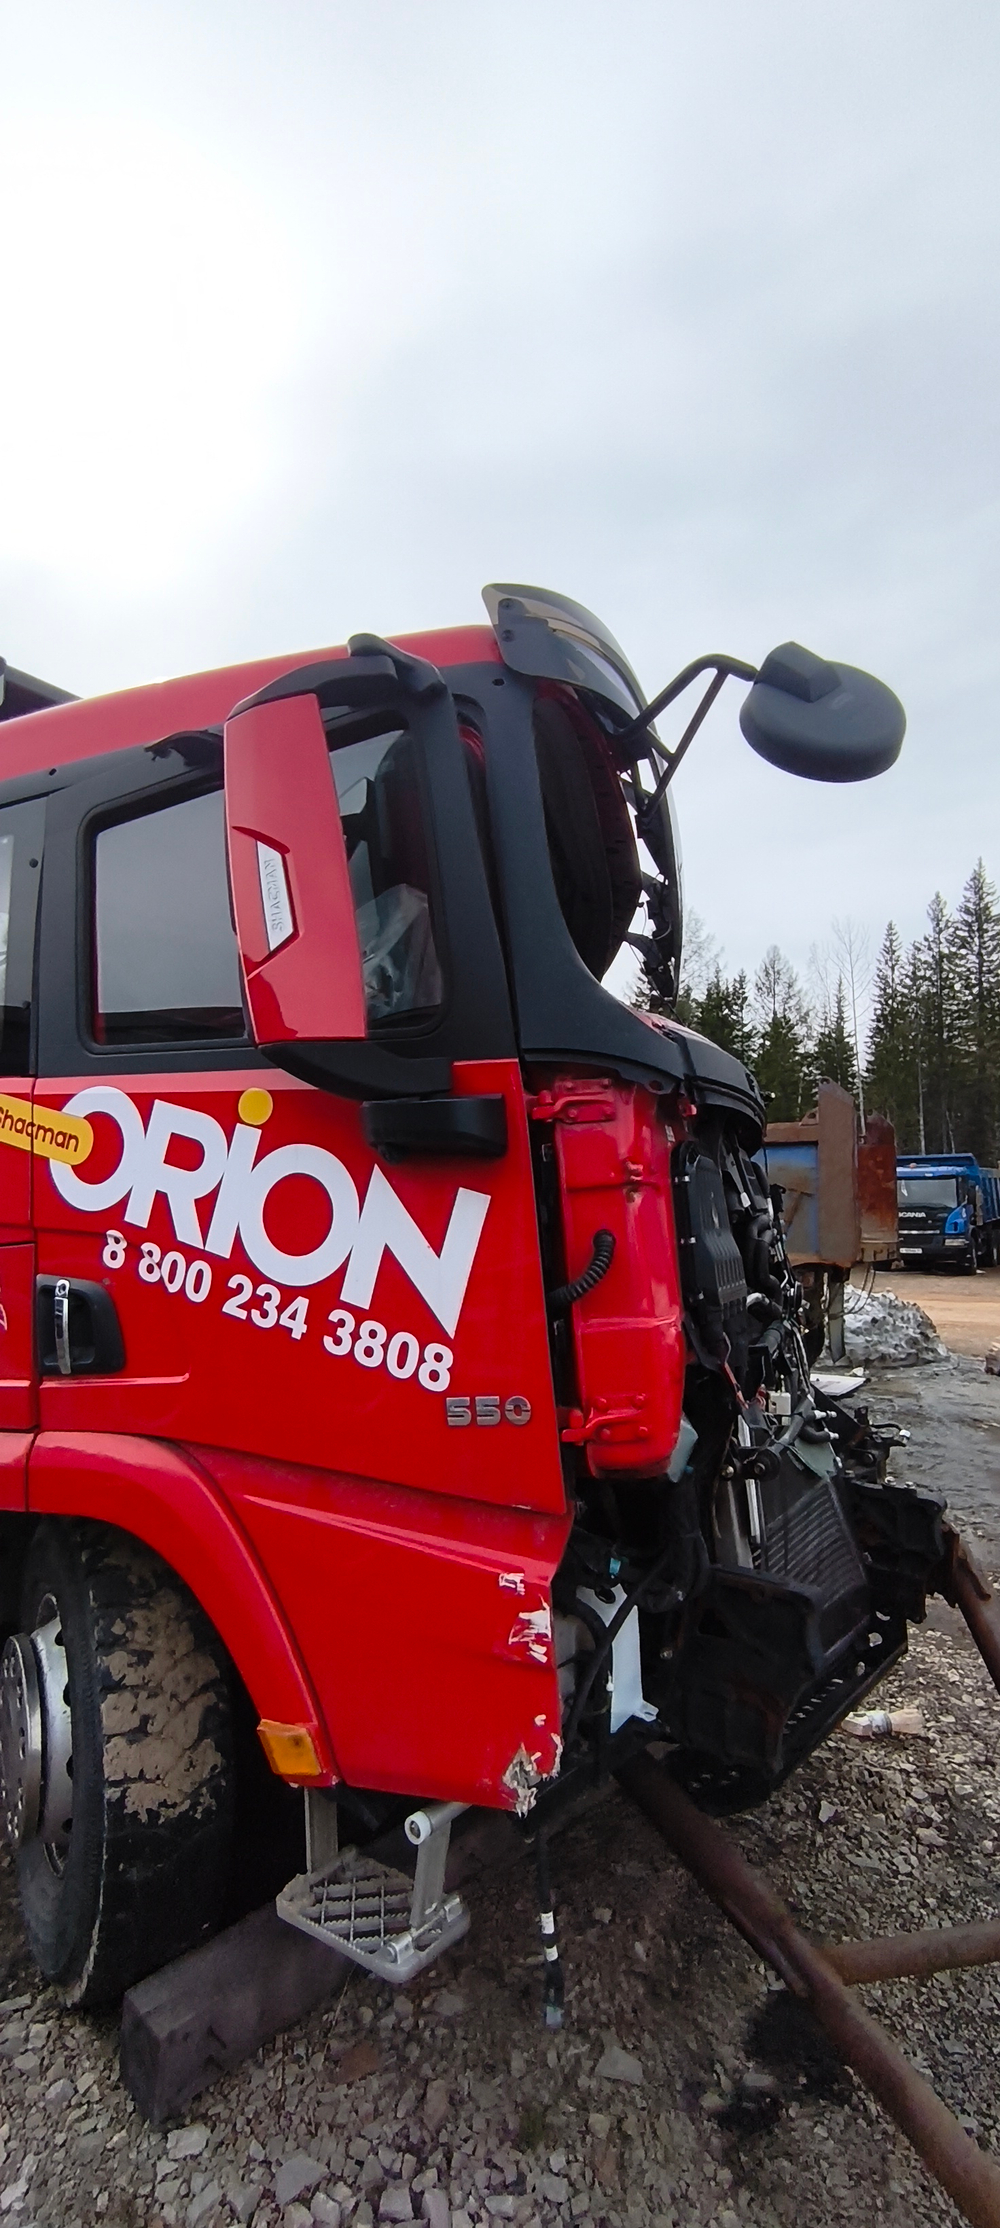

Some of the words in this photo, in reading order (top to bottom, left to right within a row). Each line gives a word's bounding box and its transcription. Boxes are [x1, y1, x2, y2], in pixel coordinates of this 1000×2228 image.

[263, 858, 285, 932] SHACMAN
[102, 1229, 127, 1269] 8
[138, 1242, 212, 1303] 800
[222, 1274, 309, 1340] 234
[323, 1309, 454, 1392] 3808
[446, 1395, 531, 1426] 550
